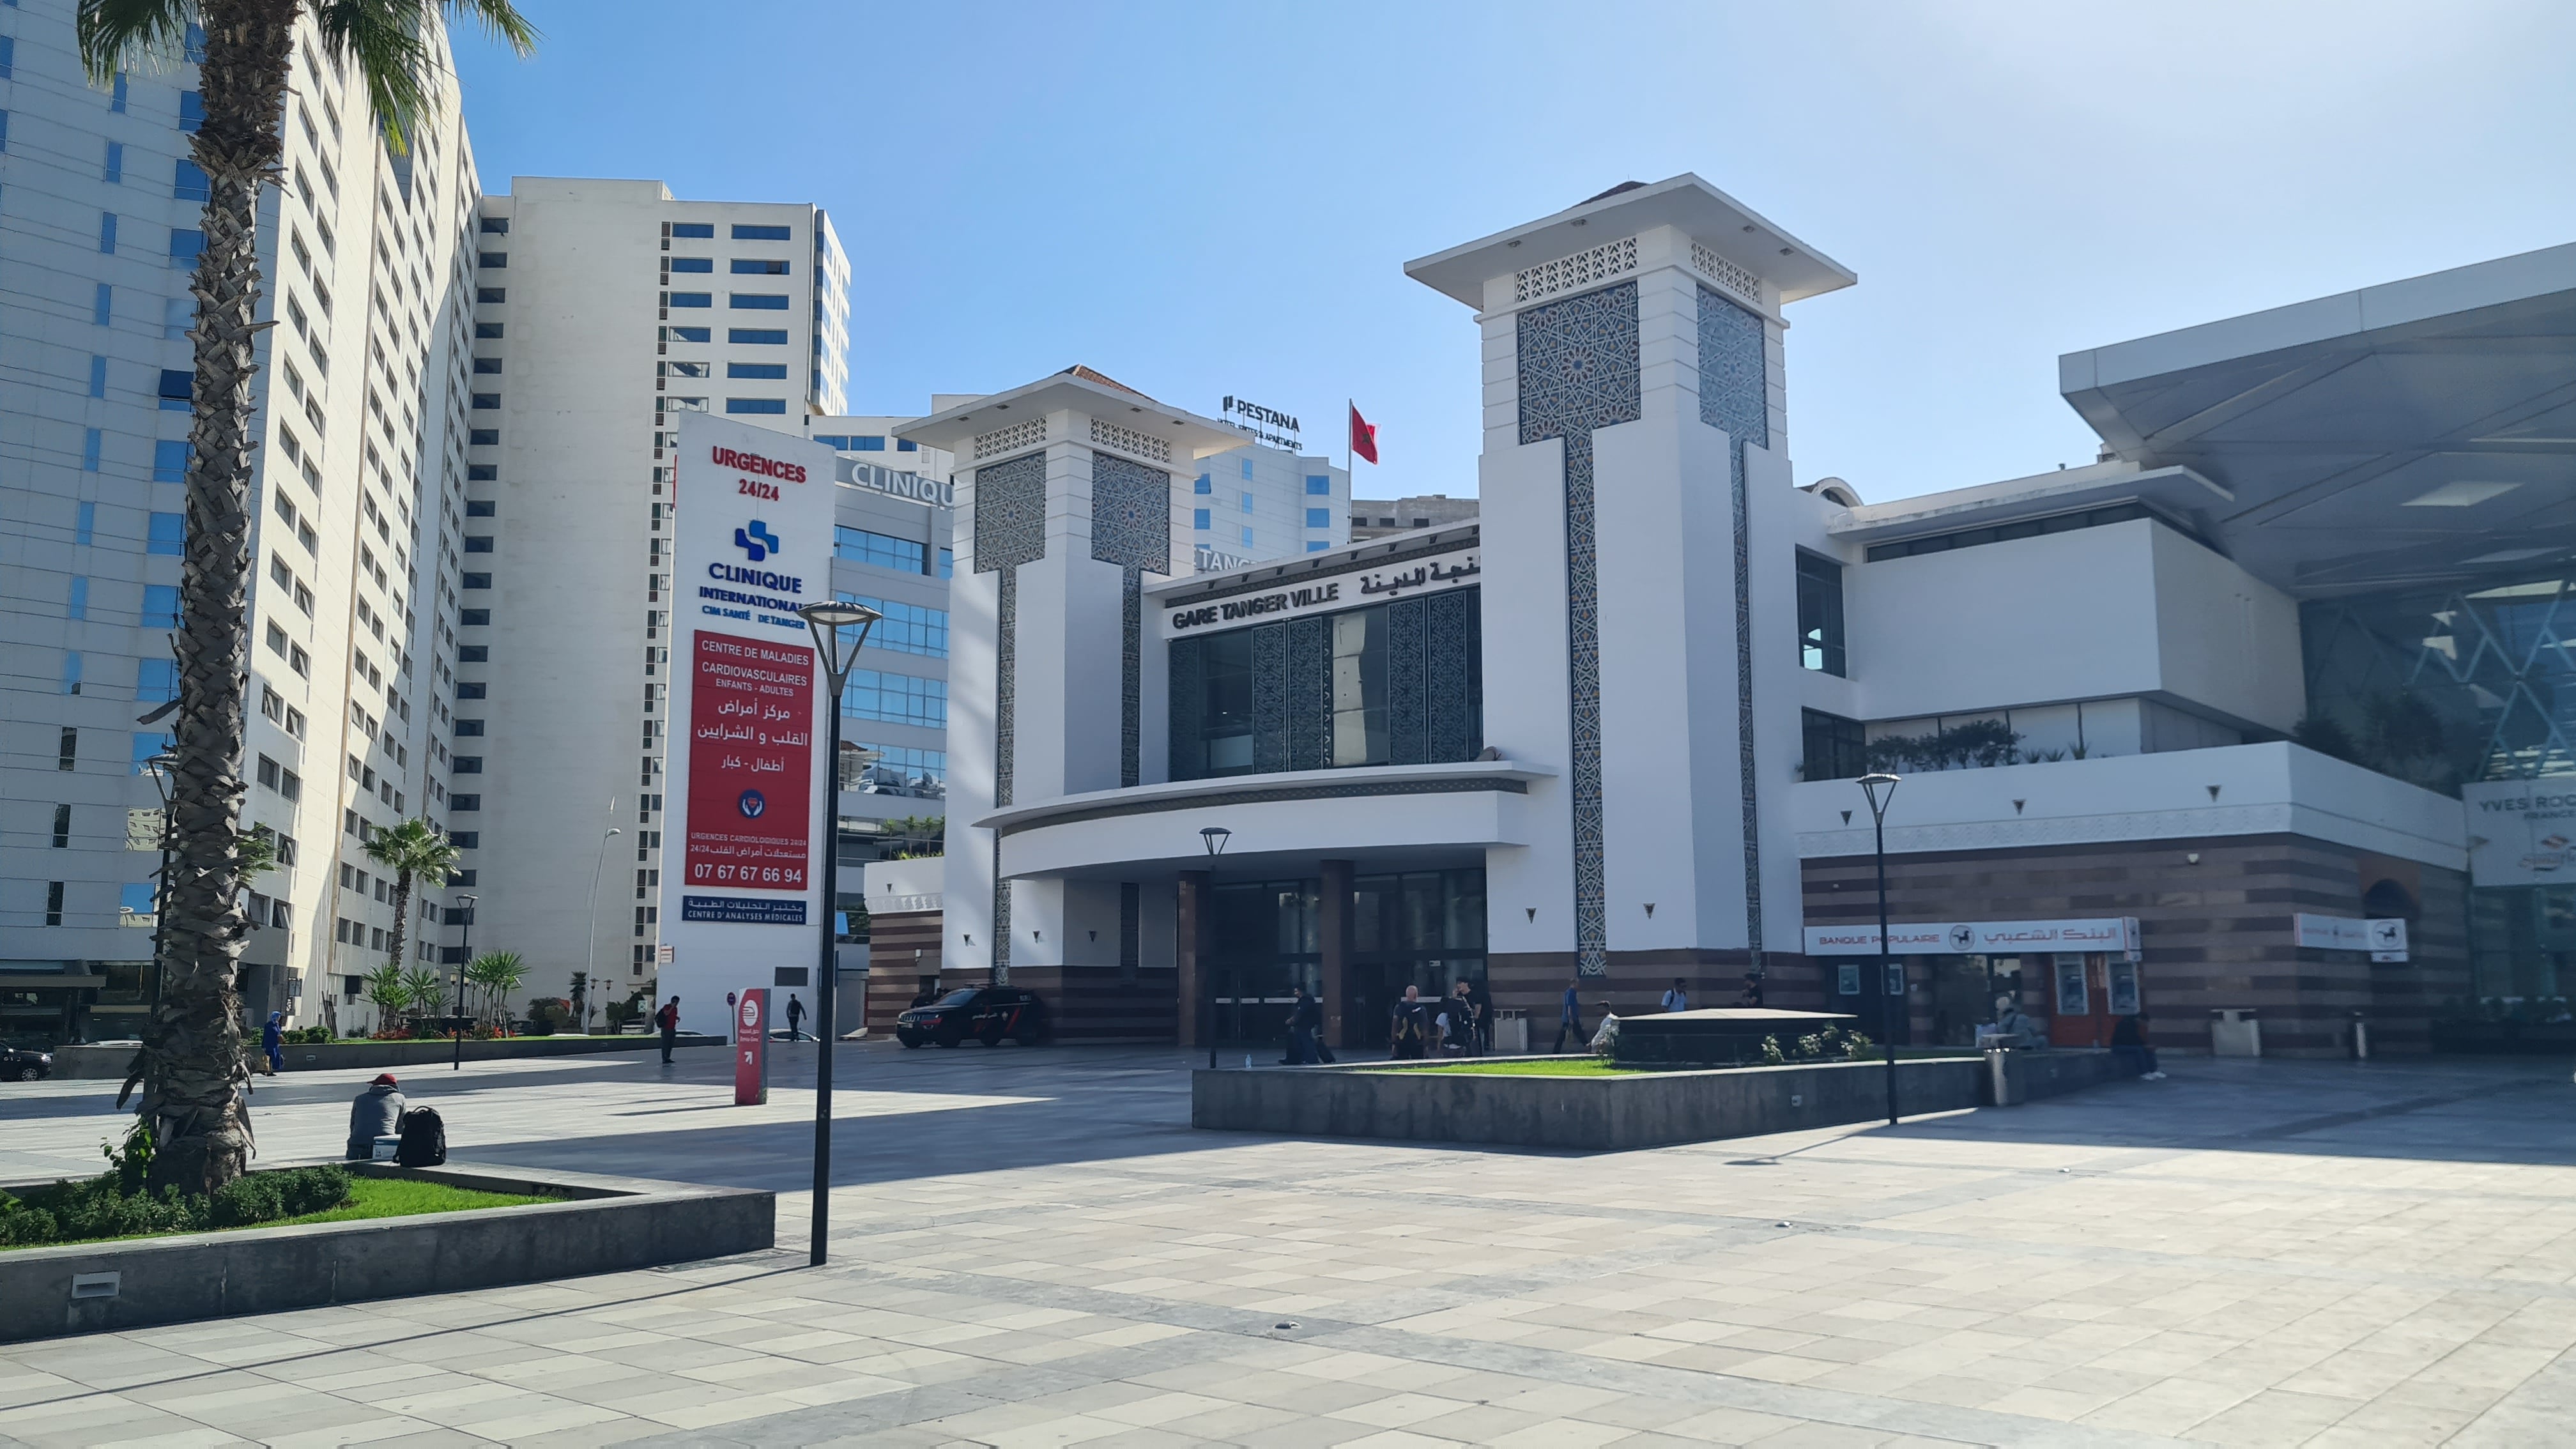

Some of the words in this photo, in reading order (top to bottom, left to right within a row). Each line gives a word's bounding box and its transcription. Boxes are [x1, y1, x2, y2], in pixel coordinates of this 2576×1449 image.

[1237, 399, 1300, 433] PESTANA
[1265, 433, 1303, 450] APARTMENTS
[712, 445, 807, 483] URGENCES
[739, 479, 779, 501] 24/24
[1199, 549, 1257, 571] TAN
[709, 563, 802, 594] CLINIQUE
[1360, 567, 1426, 596] المدينة
[1172, 606, 1218, 629] GARE
[1220, 594, 1288, 620] TANGER
[1289, 583, 1339, 608] VILLE
[702, 606, 721, 615] CIM
[723, 608, 751, 620] SANTÉ
[758, 614, 769, 624] DE
[771, 616, 806, 629] TANGER
[702, 640, 742, 656] CENTRE
[744, 647, 758, 659] DE
[760, 650, 809, 666] MALADIES
[702, 661, 808, 686] CARDIOVASCULAIRES
[716, 678, 753, 691] ENFANTS
[759, 684, 793, 697] ADULTES
[718, 698, 758, 716] أمراض
[763, 704, 790, 721] مركز
[698, 723, 754, 740] الشرايين
[759, 733, 766, 744] و
[772, 731, 808, 746] القلب
[721, 755, 741, 768] كبار
[751, 757, 785, 772] أطفال
[2478, 798, 2530, 811] YVES
[691, 832, 728, 841] URGENCES
[730, 835, 788, 845] CARDIOLOGIQUES
[710, 846, 735, 854] القلب
[736, 846, 763, 857] أمراض
[764, 848, 806, 859] مستعجلات
[694, 864, 713, 878] 07
[717, 864, 735, 879] 67
[740, 866, 758, 880] 67
[763, 867, 780, 882] 66
[785, 868, 802, 883] 94
[688, 898, 724, 908] الطبية
[726, 901, 770, 910] التحليلات
[772, 903, 803, 912] مختبر
[1820, 936, 1867, 945] BANQUE
[1871, 934, 1940, 944] PPULAIRE
[1984, 929, 2058, 945] الشعبي
[2063, 927, 2117, 944] البنك
